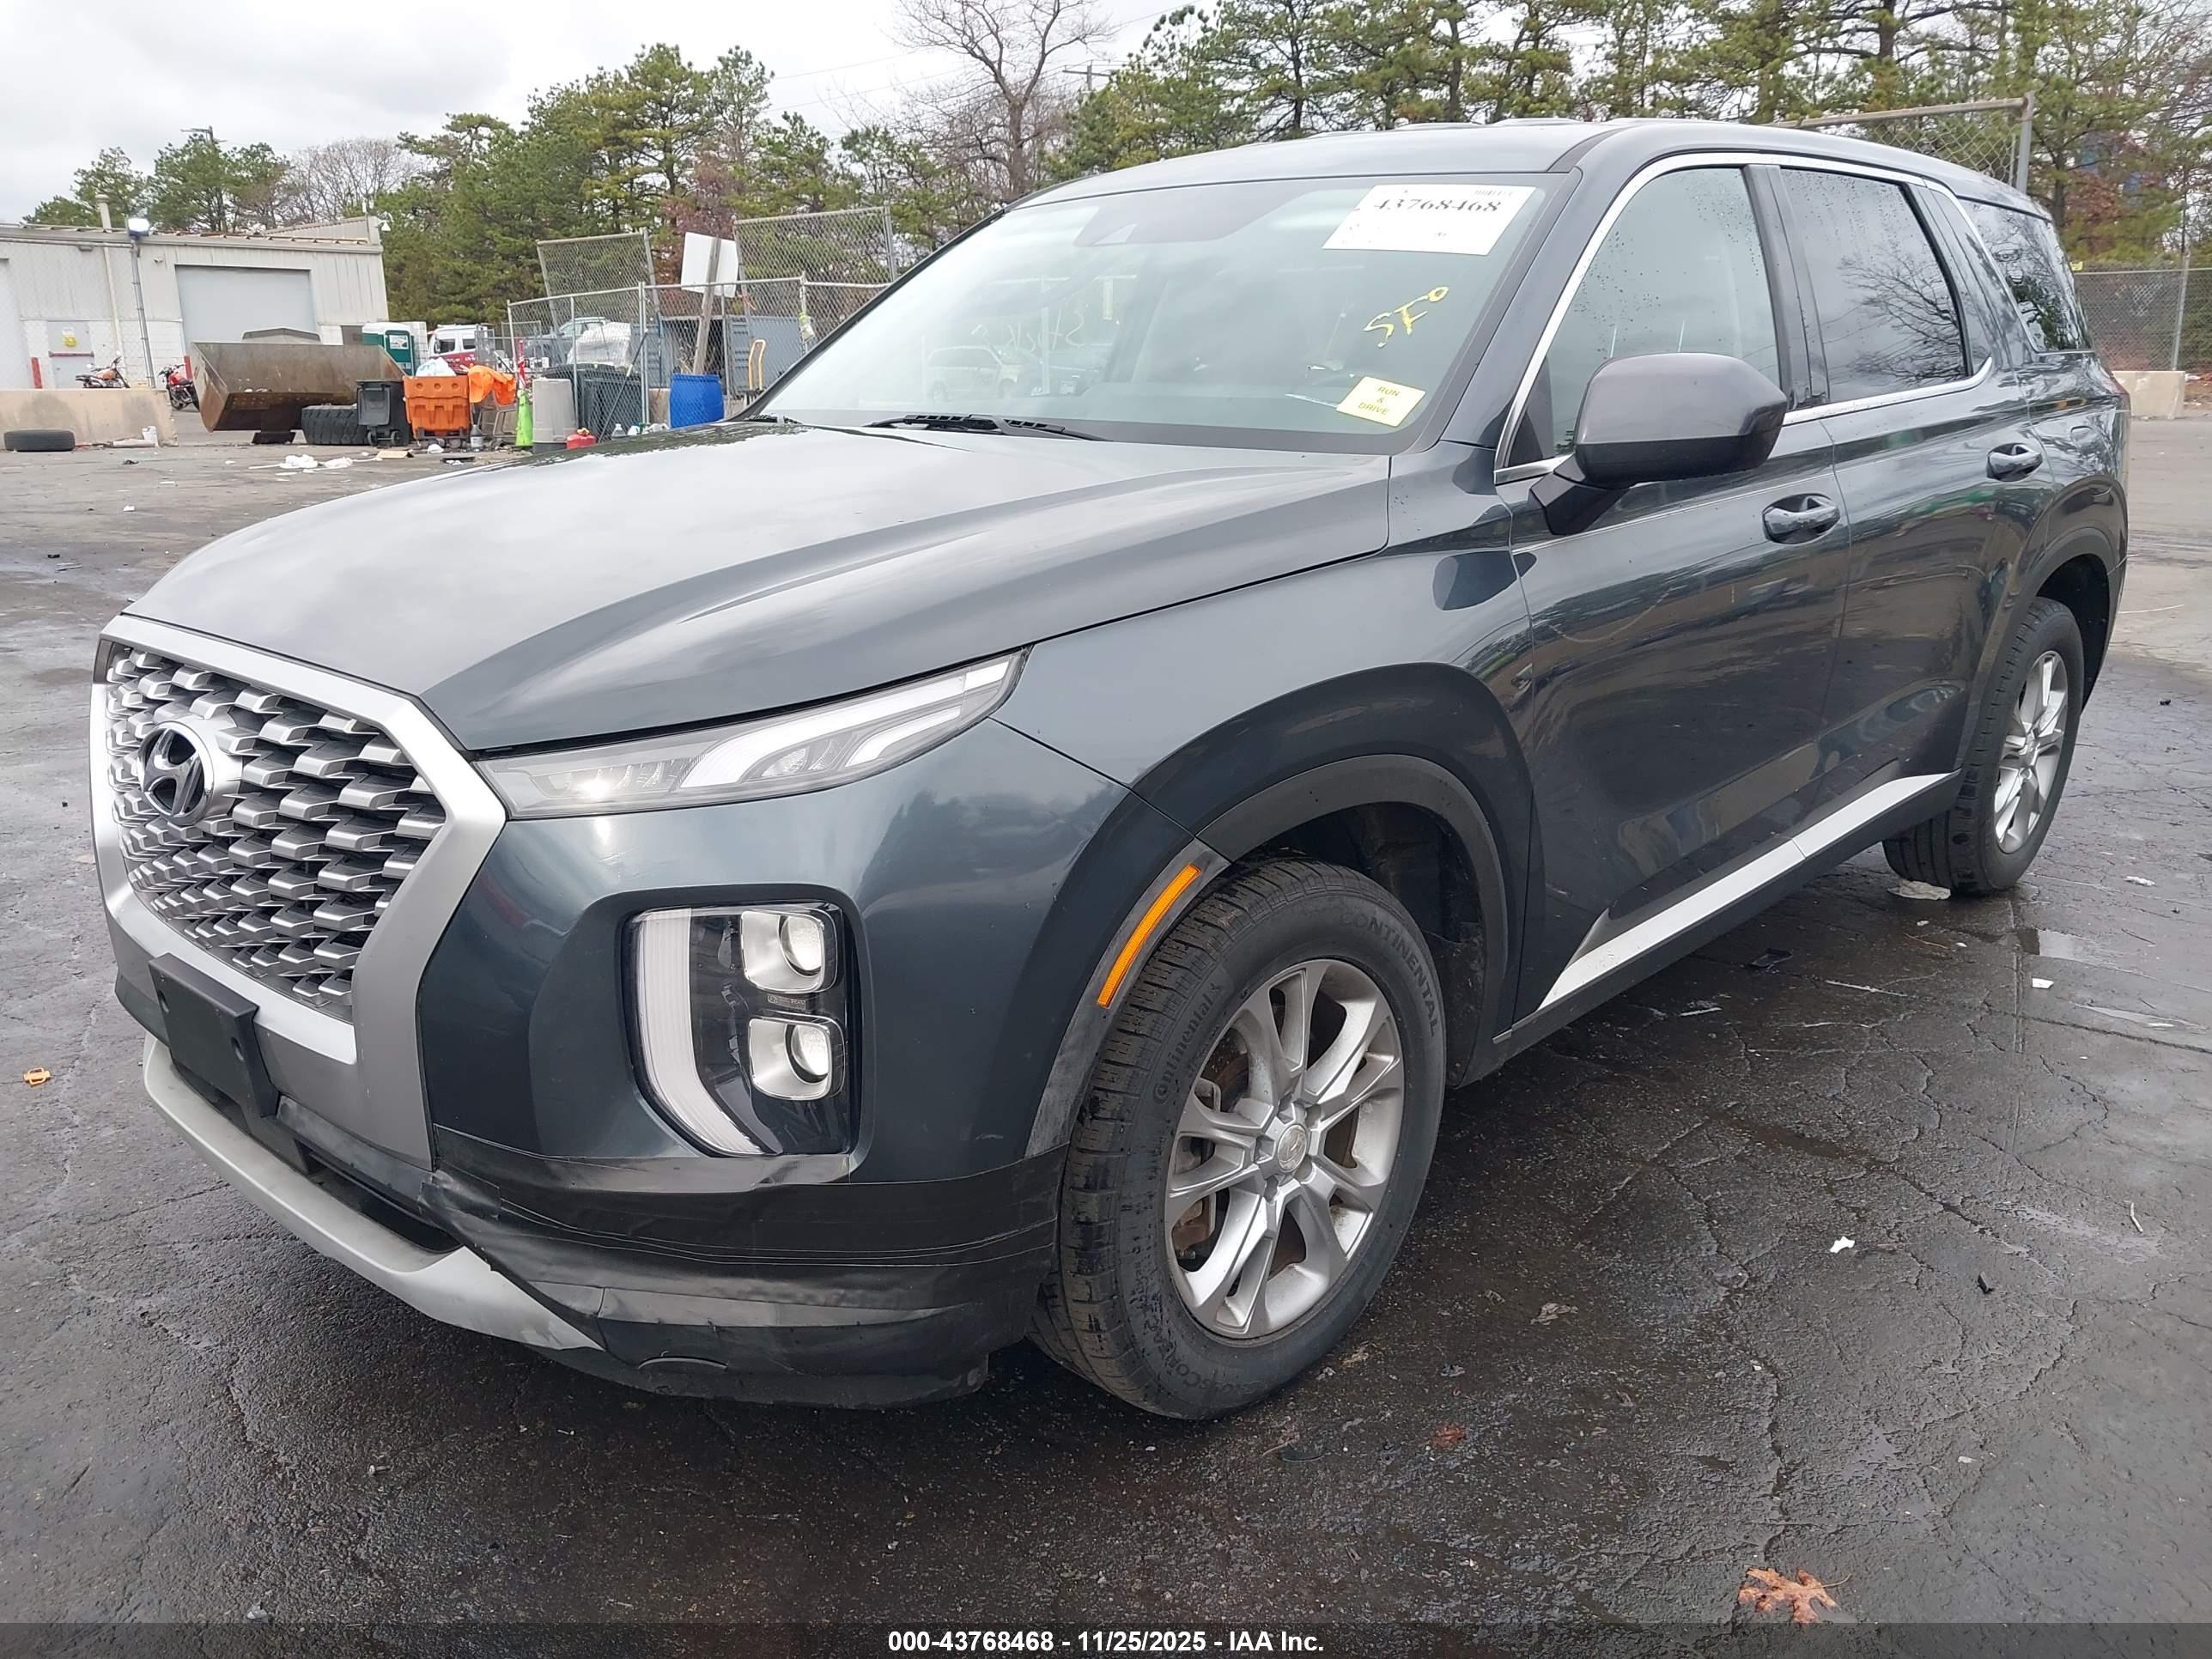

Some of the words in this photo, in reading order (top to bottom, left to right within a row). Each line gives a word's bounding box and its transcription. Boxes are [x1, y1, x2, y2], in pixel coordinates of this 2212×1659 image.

[1374, 198, 1502, 213] 43768468
[1377, 386, 1401, 398] RUN
[1358, 402, 1390, 416] DRIVE
[1338, 912, 1441, 1038] CONTINENTAL
